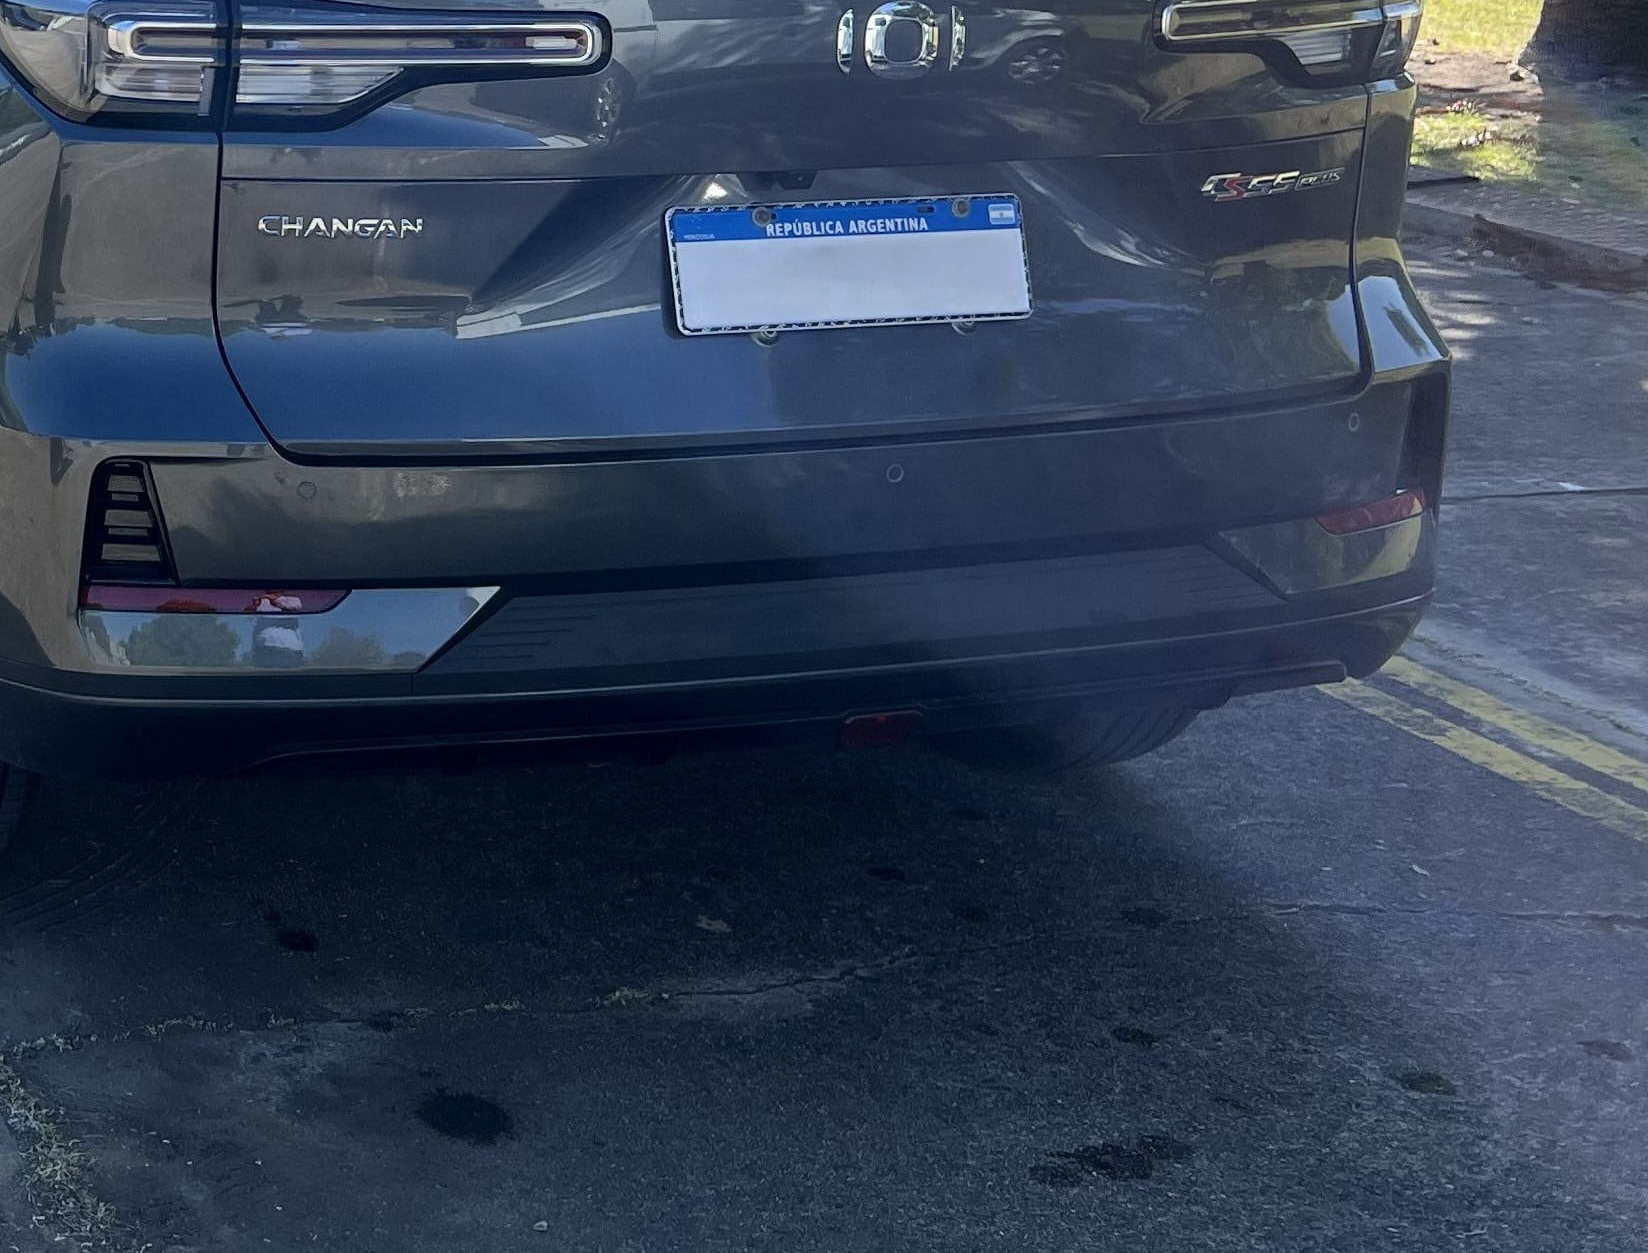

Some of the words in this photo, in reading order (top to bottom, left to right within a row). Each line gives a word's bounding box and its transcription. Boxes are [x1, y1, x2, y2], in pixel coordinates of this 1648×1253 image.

[258, 215, 423, 240] CHANGAN
[765, 217, 844, 237] REPÚBLICA
[848, 217, 929, 233] ARGENTINA
